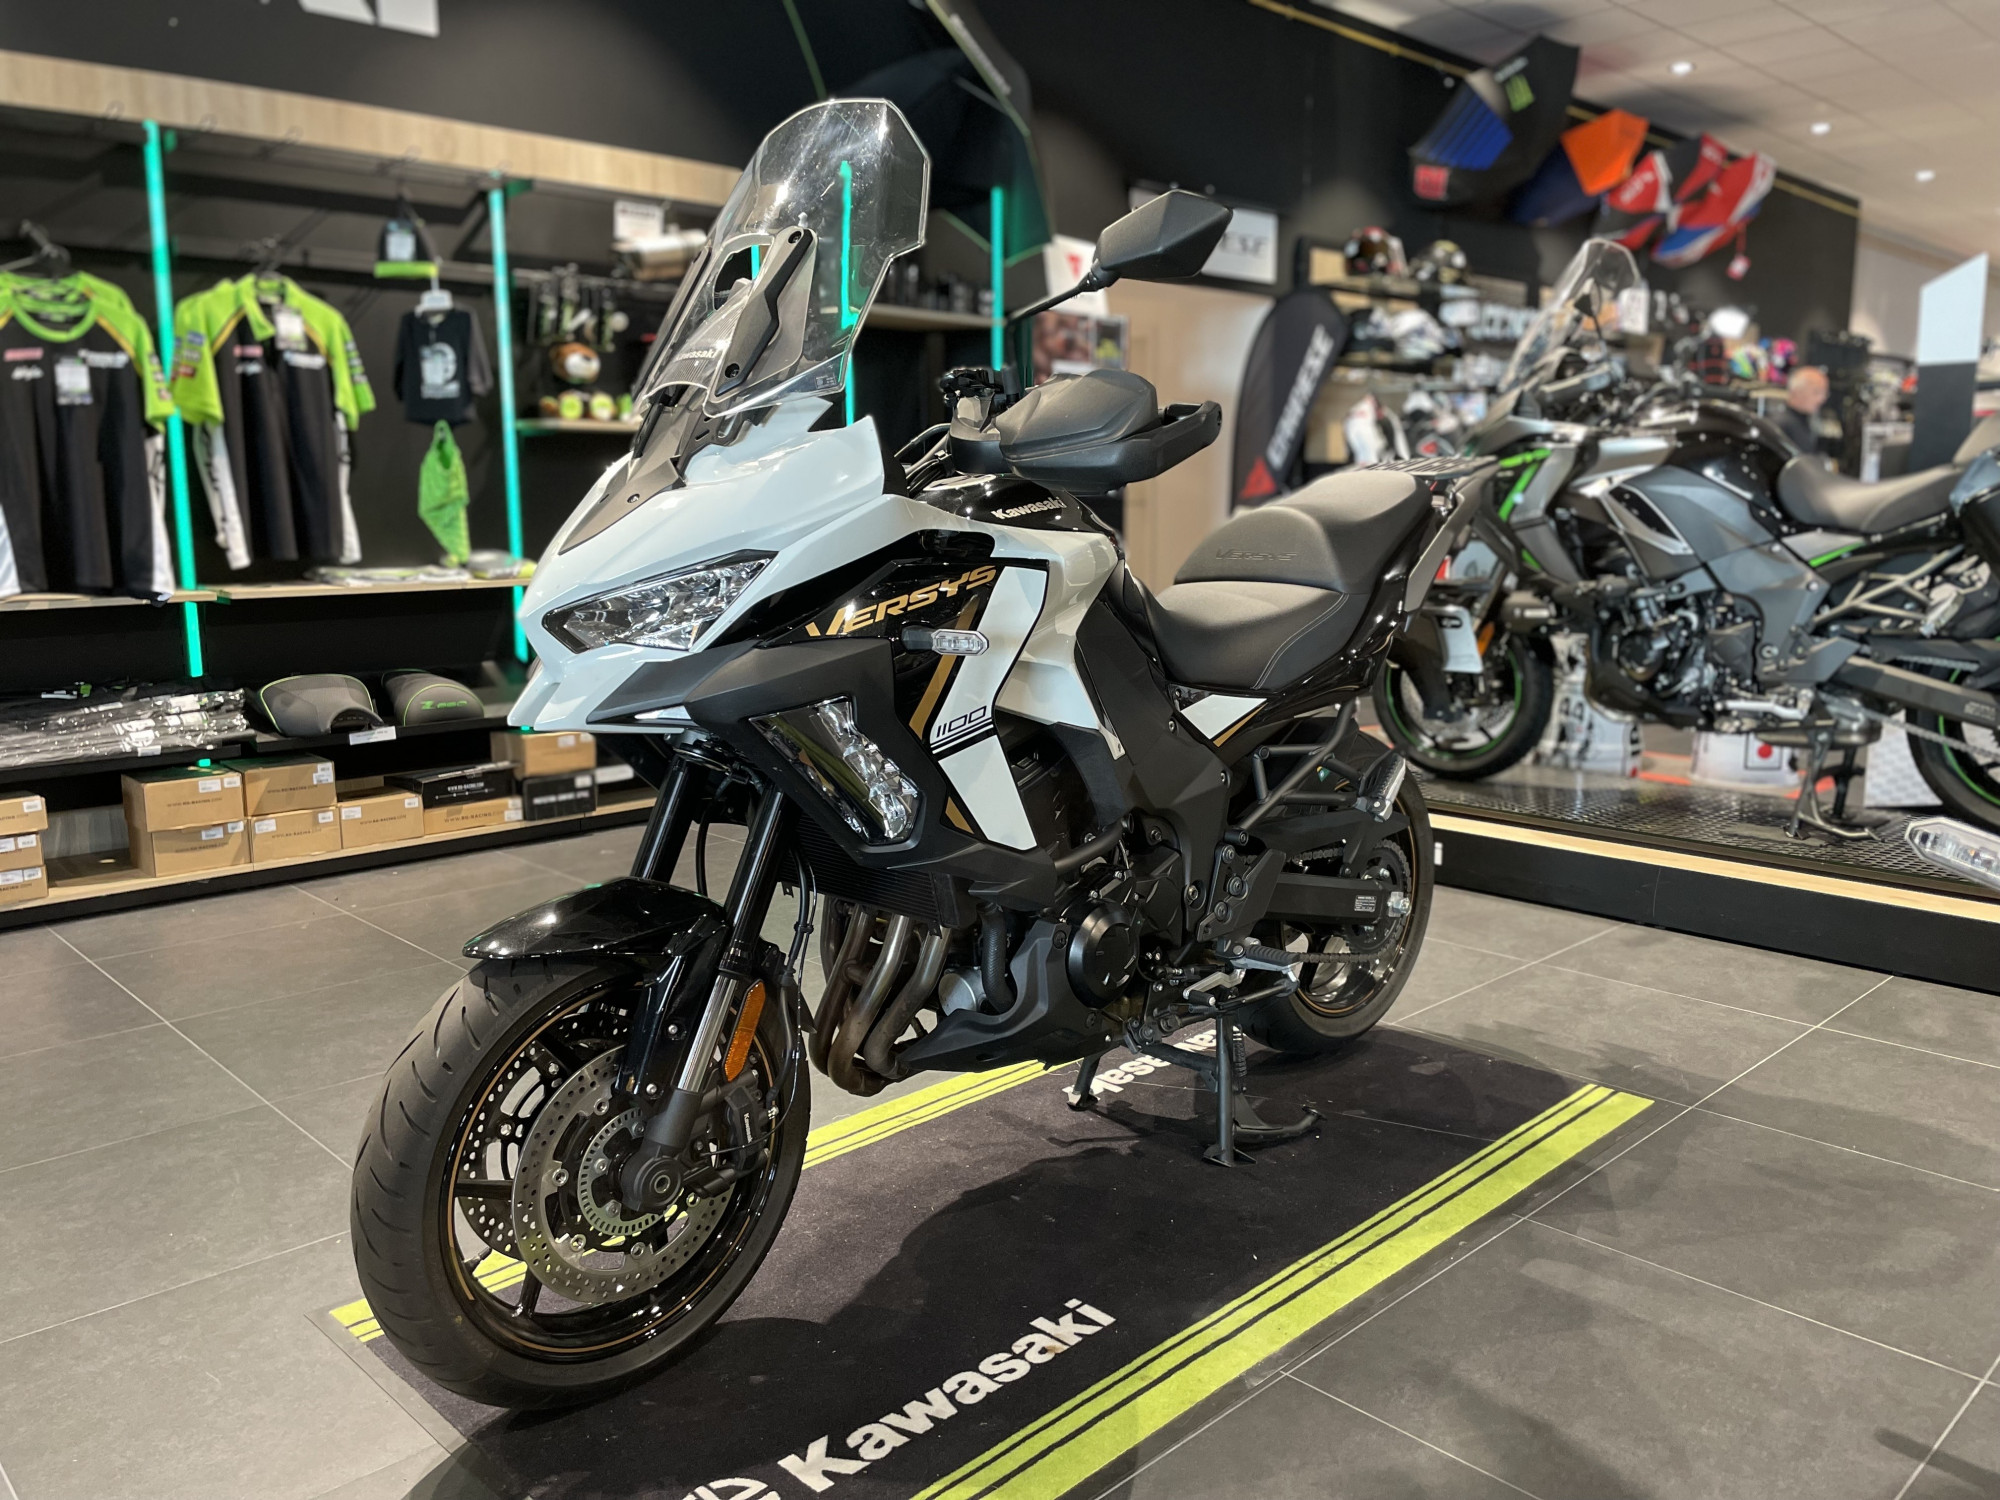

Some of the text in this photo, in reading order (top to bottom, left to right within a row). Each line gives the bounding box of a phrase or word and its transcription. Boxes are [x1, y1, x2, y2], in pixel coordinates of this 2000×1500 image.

[992, 496, 1067, 520] Kawasaki
[805, 565, 997, 636] VERSYS
[936, 706, 987, 737] 1100
[743, 1112, 753, 1143] Kawasak
[778, 1297, 1116, 1492] Kawasaki
